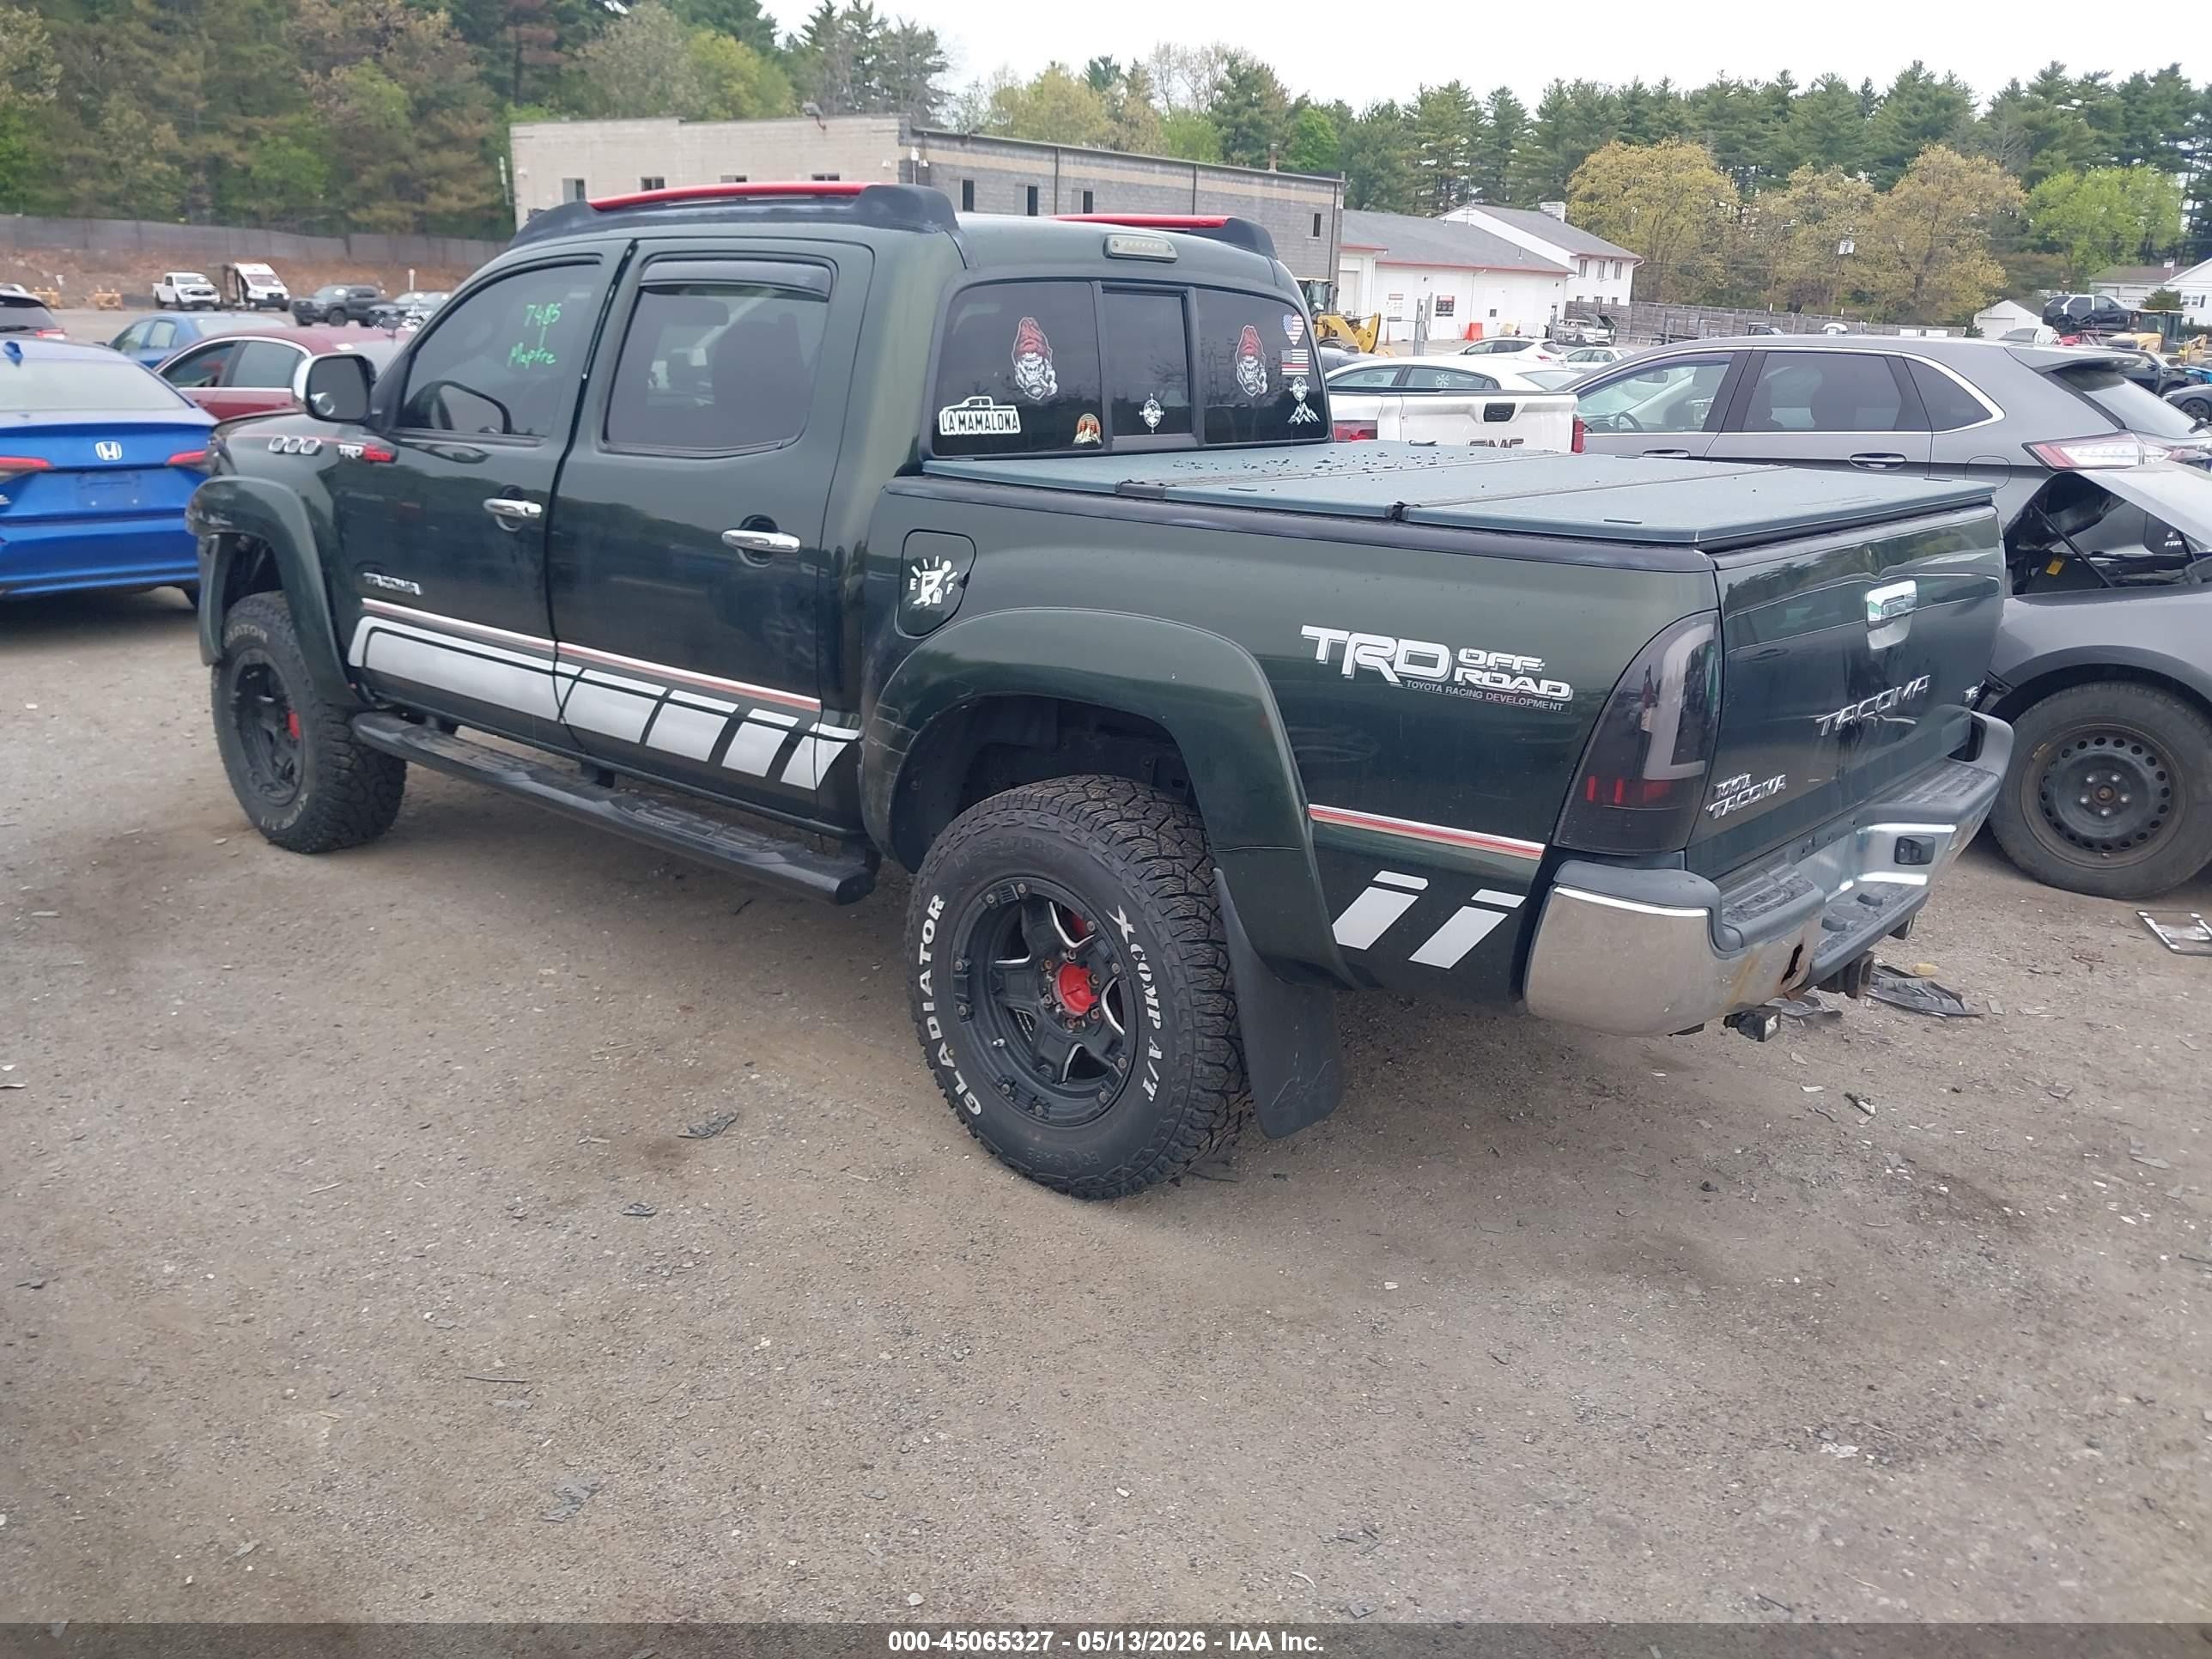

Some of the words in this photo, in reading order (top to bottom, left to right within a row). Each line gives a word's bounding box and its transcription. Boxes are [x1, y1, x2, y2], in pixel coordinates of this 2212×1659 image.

[524, 302, 562, 327] 7485
[942, 413, 956, 432] LA
[958, 413, 1018, 432] MAMALONA
[1300, 624, 1453, 687] TRD
[1456, 646, 1546, 673] OFF
[1406, 679, 1443, 694] TOYOTA
[1445, 685, 1484, 700] RACING
[1486, 692, 1565, 712] DEVELOPMENT
[1453, 667, 1574, 702] ROAD
[1815, 674, 1931, 737] TACOMA
[1705, 774, 1787, 820] TACOMA
[1106, 904, 1136, 944] X
[919, 894, 982, 1115] GLADIATOR
[1129, 943, 1162, 1030] COMP
[1141, 1036, 1163, 1103] A/T
